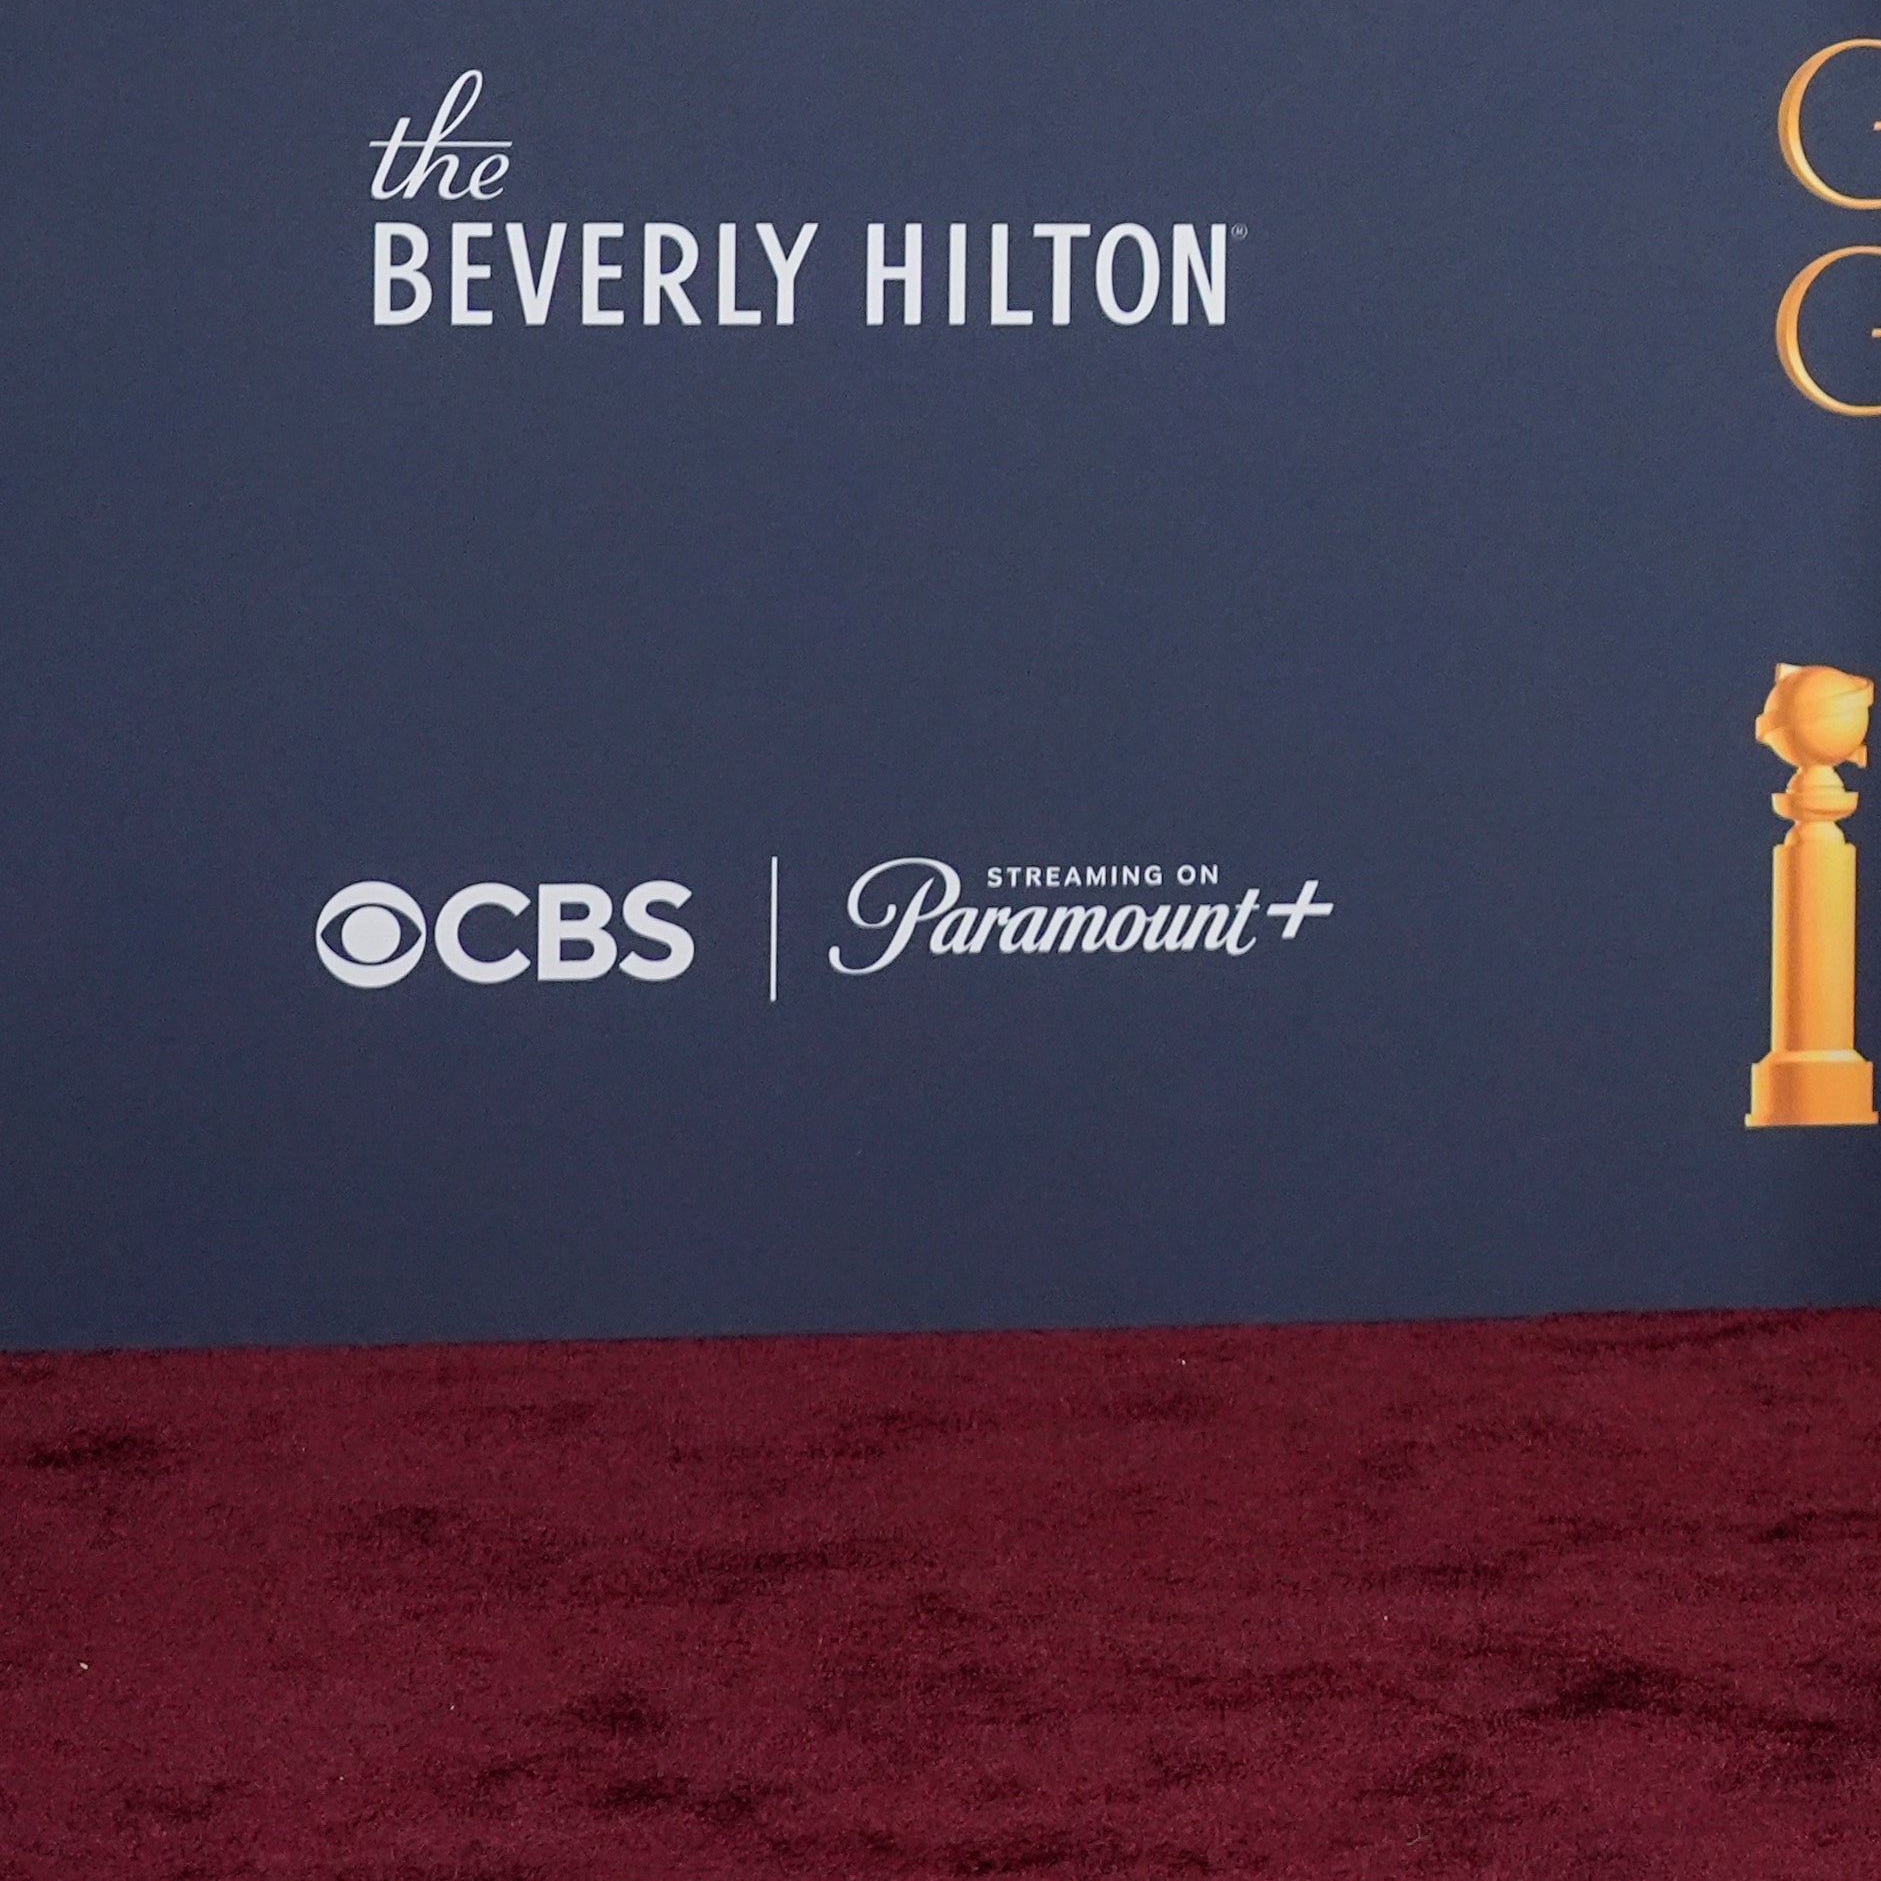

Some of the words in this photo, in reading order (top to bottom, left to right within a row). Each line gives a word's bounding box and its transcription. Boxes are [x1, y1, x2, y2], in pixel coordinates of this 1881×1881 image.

[369, 69, 513, 201] the
[373, 221, 819, 327] BEVERLY
[987, 864, 1163, 889] STREAMING
[1176, 863, 1219, 886] ON
[435, 879, 695, 985] CBS
